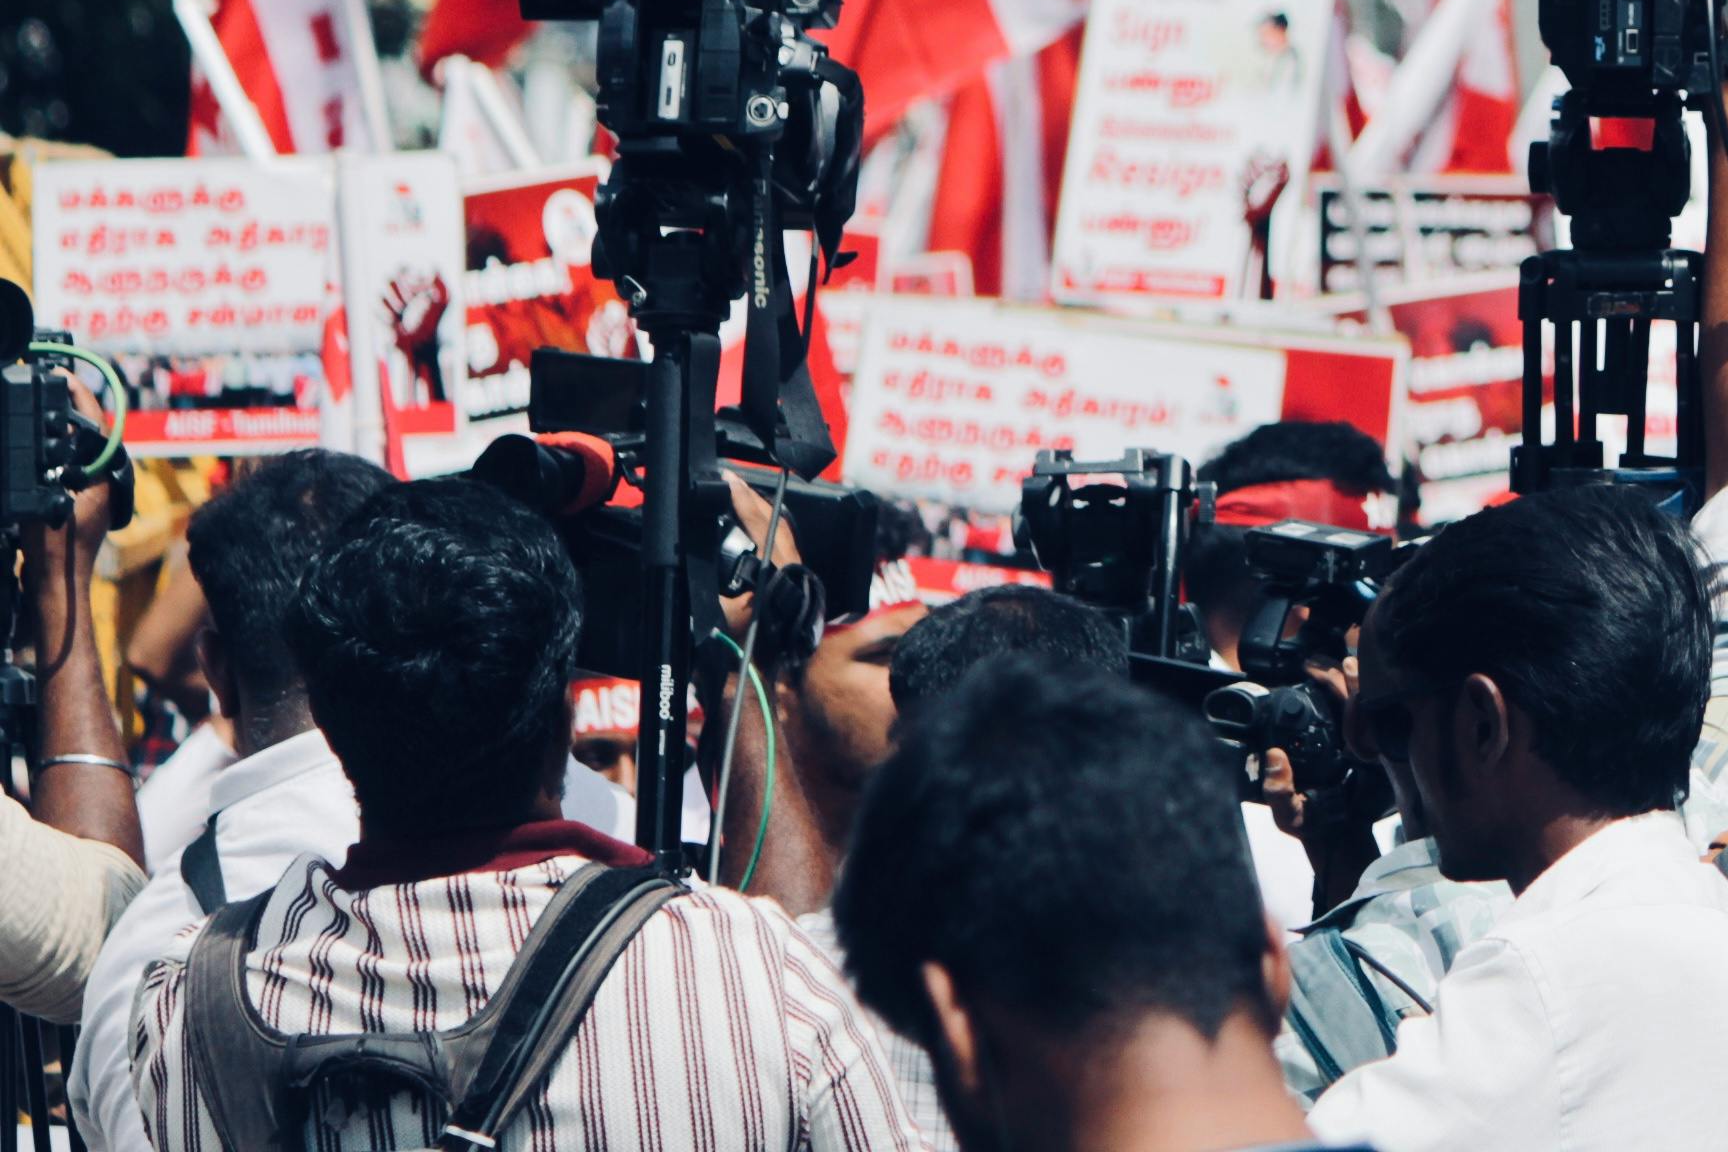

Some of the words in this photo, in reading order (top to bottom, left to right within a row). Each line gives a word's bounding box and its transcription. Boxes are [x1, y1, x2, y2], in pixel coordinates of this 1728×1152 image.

[205, 221, 330, 253] அதிகார
[752, 178, 771, 310] Panasonic
[188, 304, 319, 331] சன்மான
[575, 684, 640, 734] AIS
